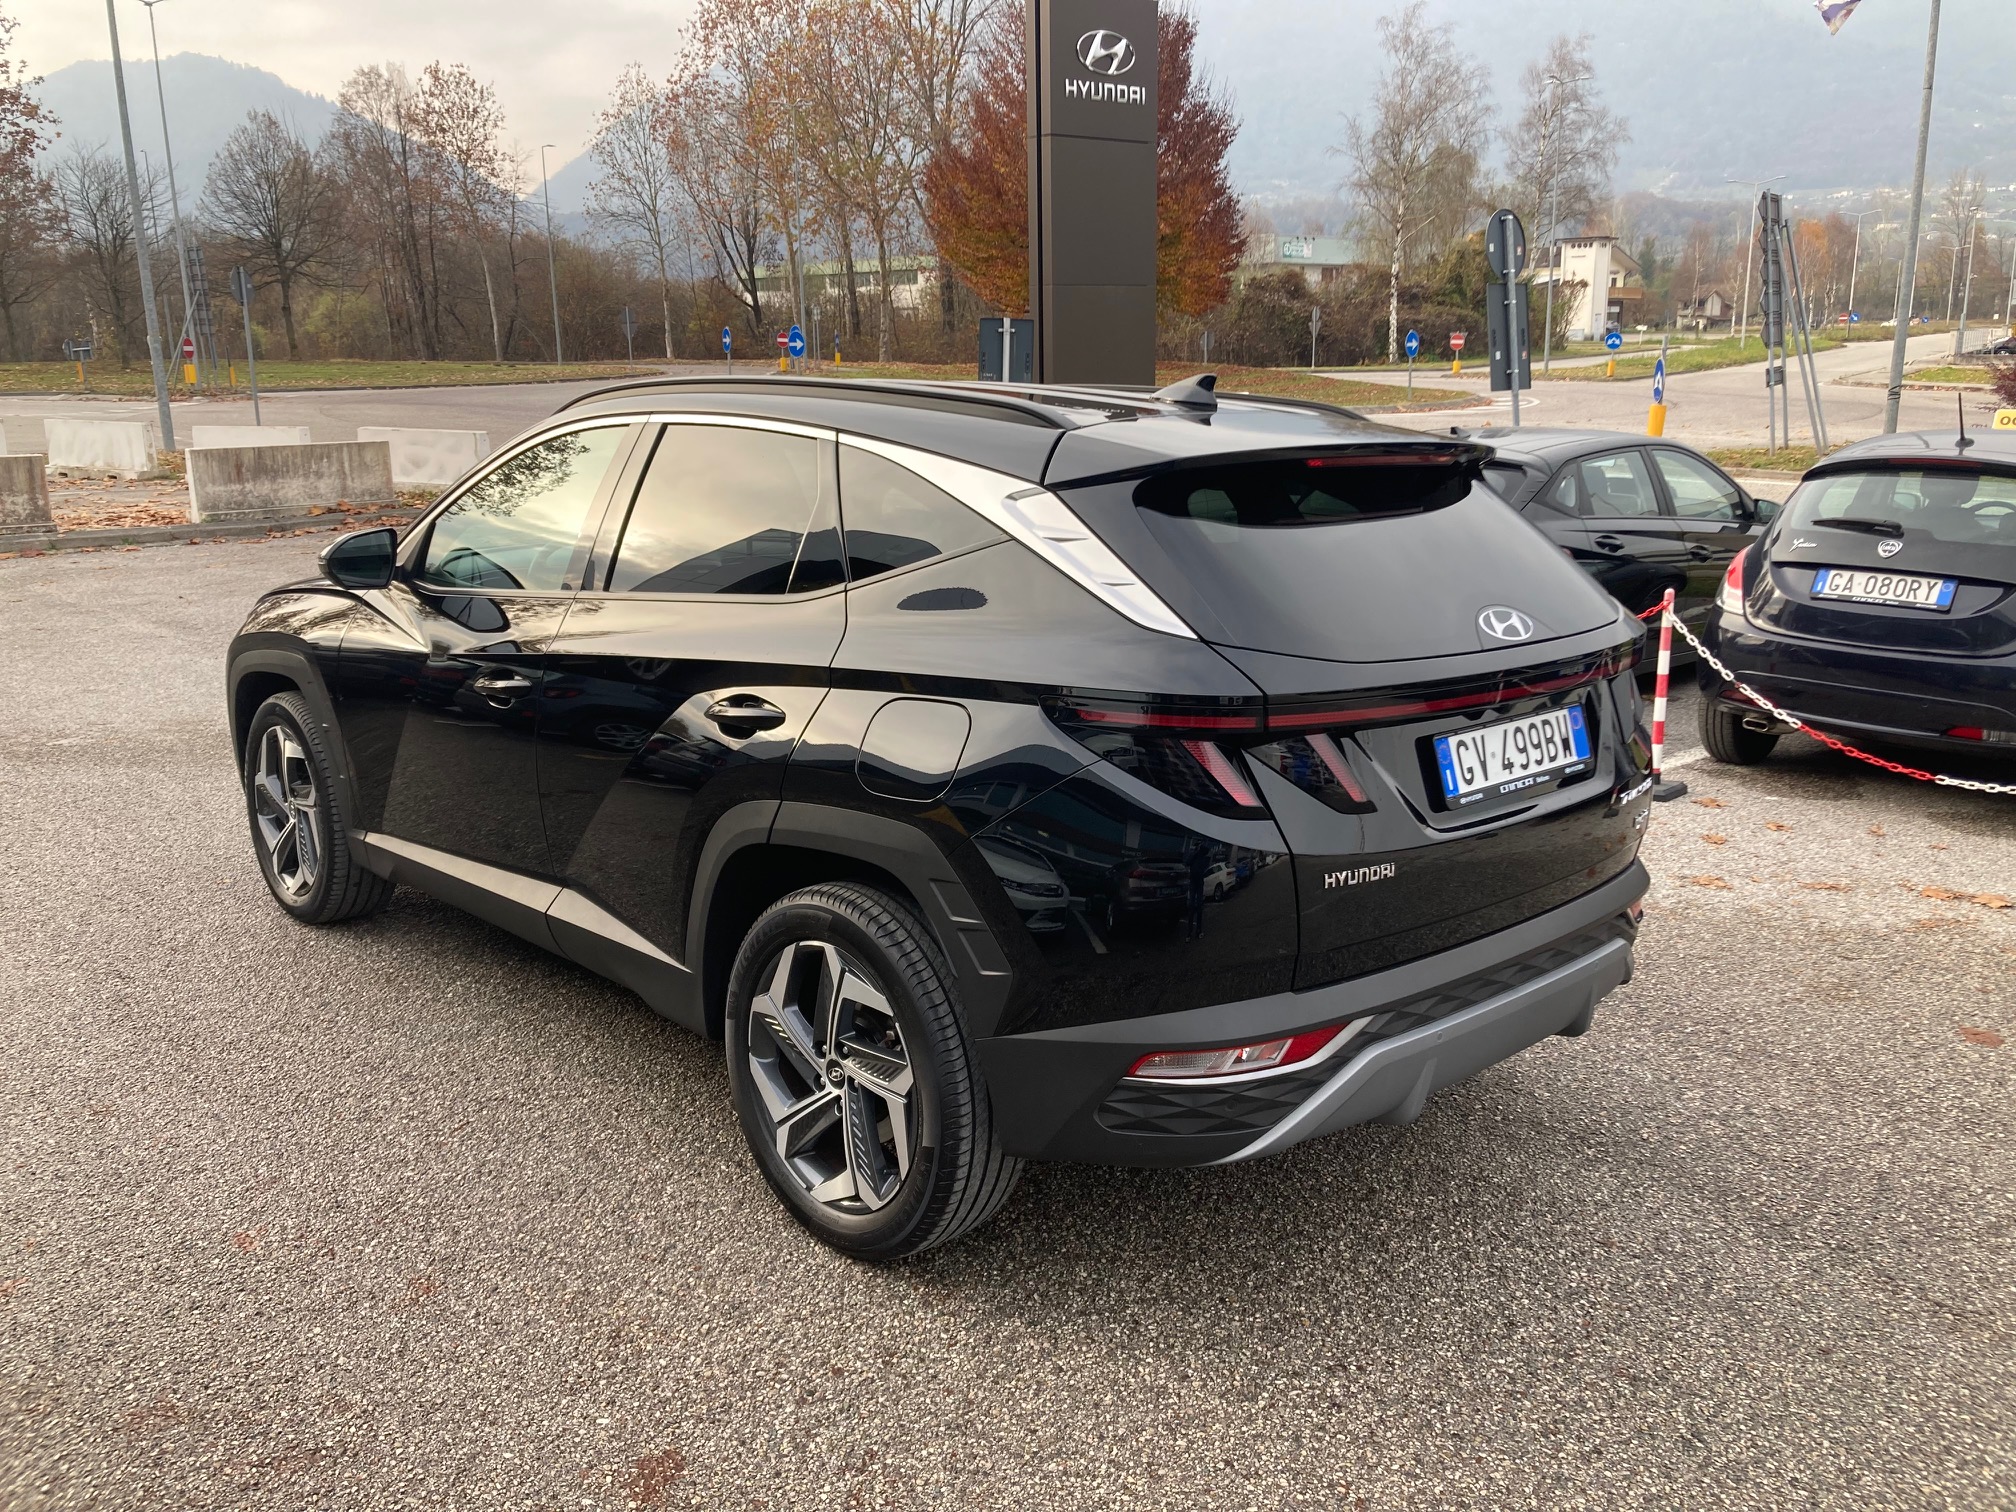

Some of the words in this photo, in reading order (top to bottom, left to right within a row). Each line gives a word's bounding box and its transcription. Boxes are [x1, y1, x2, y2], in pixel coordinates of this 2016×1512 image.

[1065, 78, 1146, 105] HYUNDAI
[1828, 572, 1855, 593] GA
[1863, 575, 1939, 602] 080RY
[1456, 734, 1489, 786] GV
[1502, 714, 1573, 775] 499BW
[1324, 862, 1396, 889] HYUNDAI
